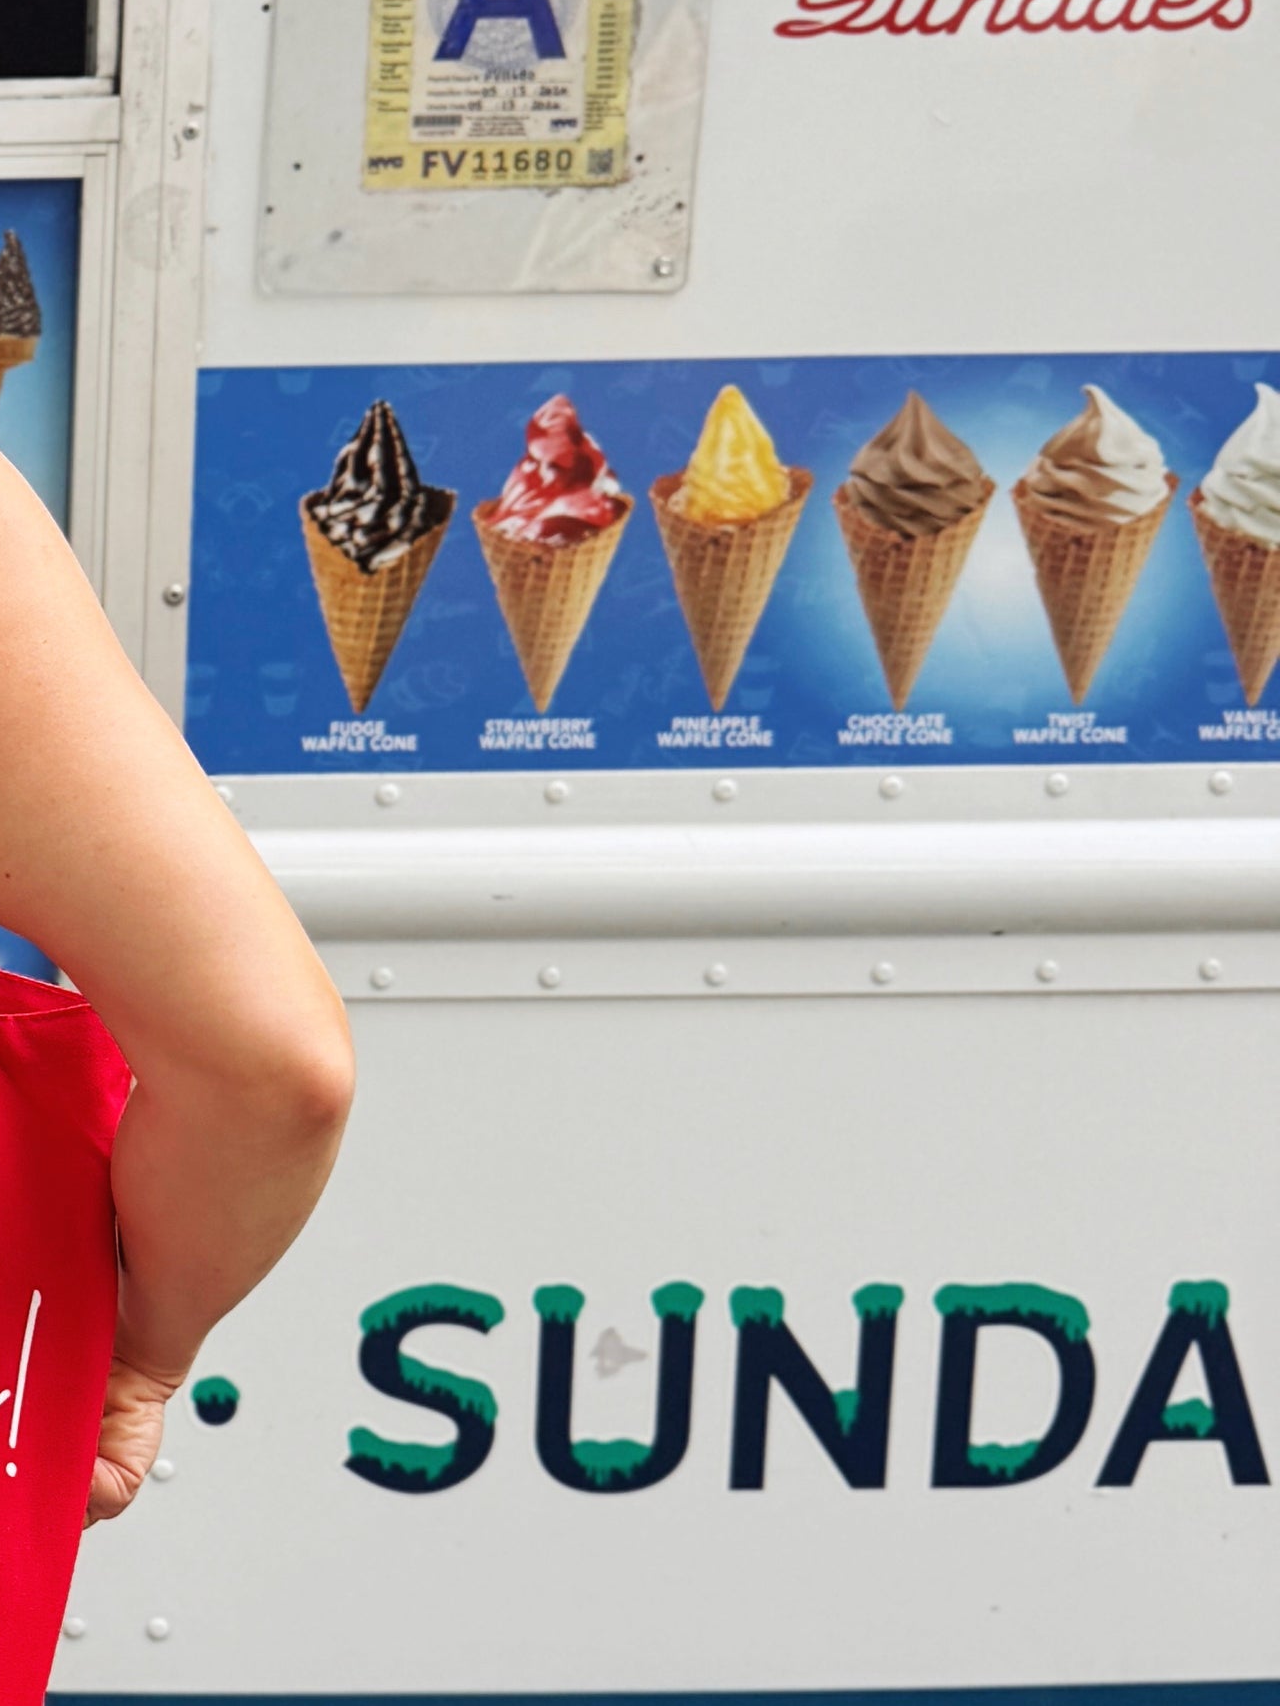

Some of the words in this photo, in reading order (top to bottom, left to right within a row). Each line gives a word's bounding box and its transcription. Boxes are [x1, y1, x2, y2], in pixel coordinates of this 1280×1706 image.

[421, 149, 573, 179] FV11680
[484, 719, 592, 734] STRAWBERRY
[672, 717, 760, 731] PINEAPPLE
[847, 714, 945, 730] CHOCOLATE
[1048, 713, 1096, 728] TWIST
[1223, 711, 1280, 726] VANILL
[329, 720, 385, 736] FUDGE
[1014, 727, 1077, 744] WAFFLE
[1081, 727, 1127, 744] CONE
[1199, 725, 1262, 741] WAFFLE
[302, 735, 365, 752] WAFFLE
[371, 735, 417, 752] CONE
[479, 733, 543, 750] WAFFLE
[547, 733, 595, 750] CONE
[657, 731, 721, 747] WAFFLE
[726, 731, 772, 747] CONE
[838, 729, 902, 745] WAFFLE
[906, 729, 952, 745] CONE
[343, 1280, 1272, 1494] SUNDA
